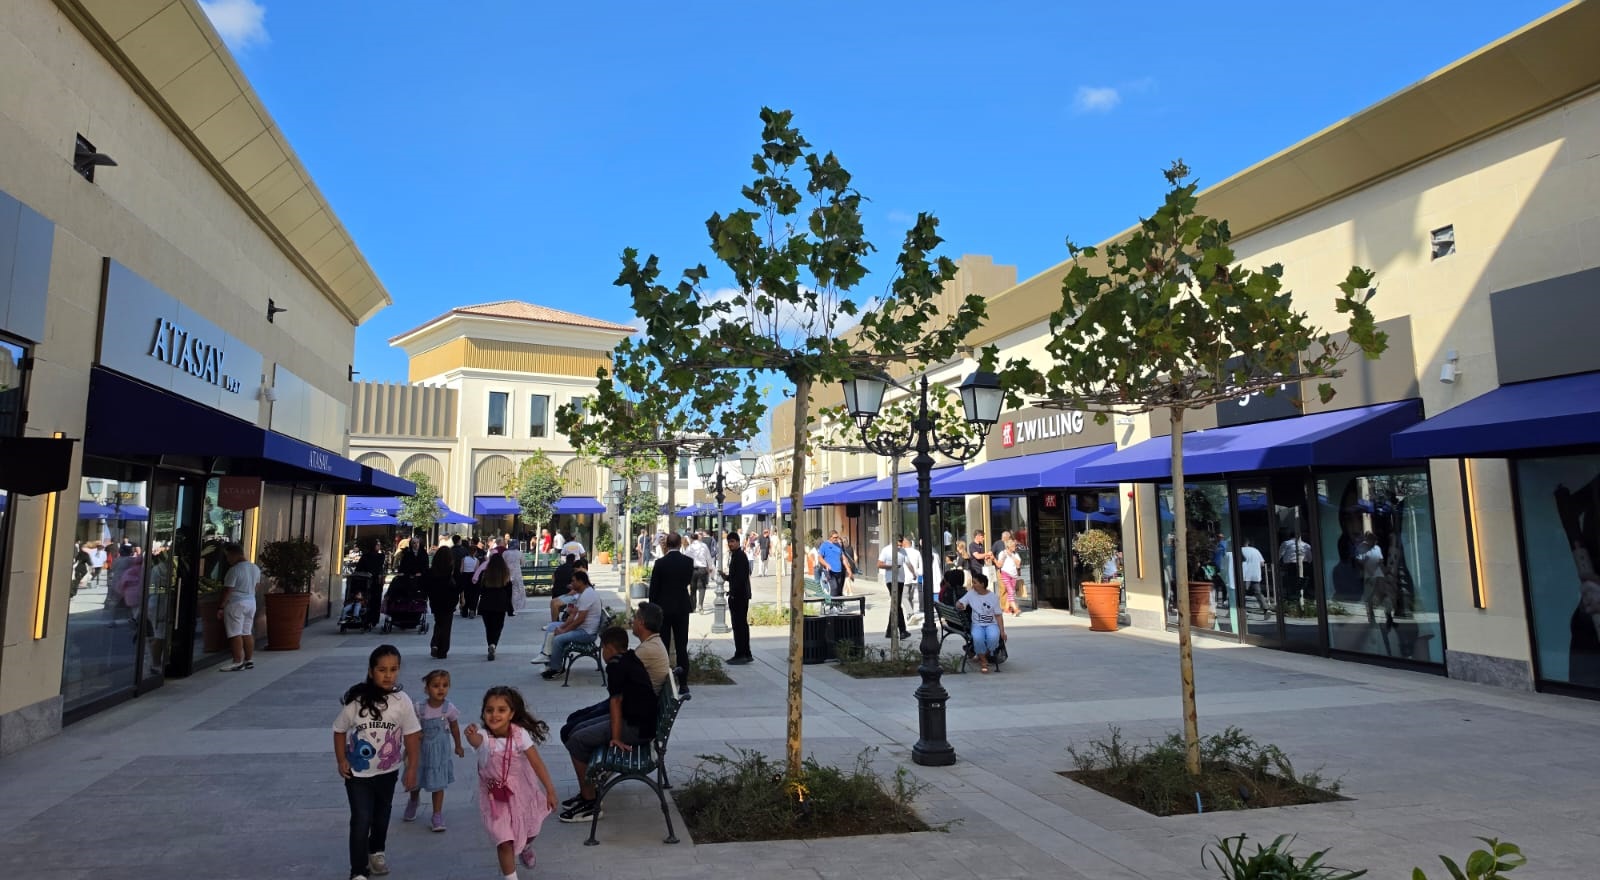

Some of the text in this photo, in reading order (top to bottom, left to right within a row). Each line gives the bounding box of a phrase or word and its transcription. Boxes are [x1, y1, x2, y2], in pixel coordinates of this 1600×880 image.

[151, 318, 225, 386] ATASAY
[1016, 409, 1085, 442] ZWILLING
[308, 450, 329, 471] ATASAY
[368, 721, 397, 731] HEART
